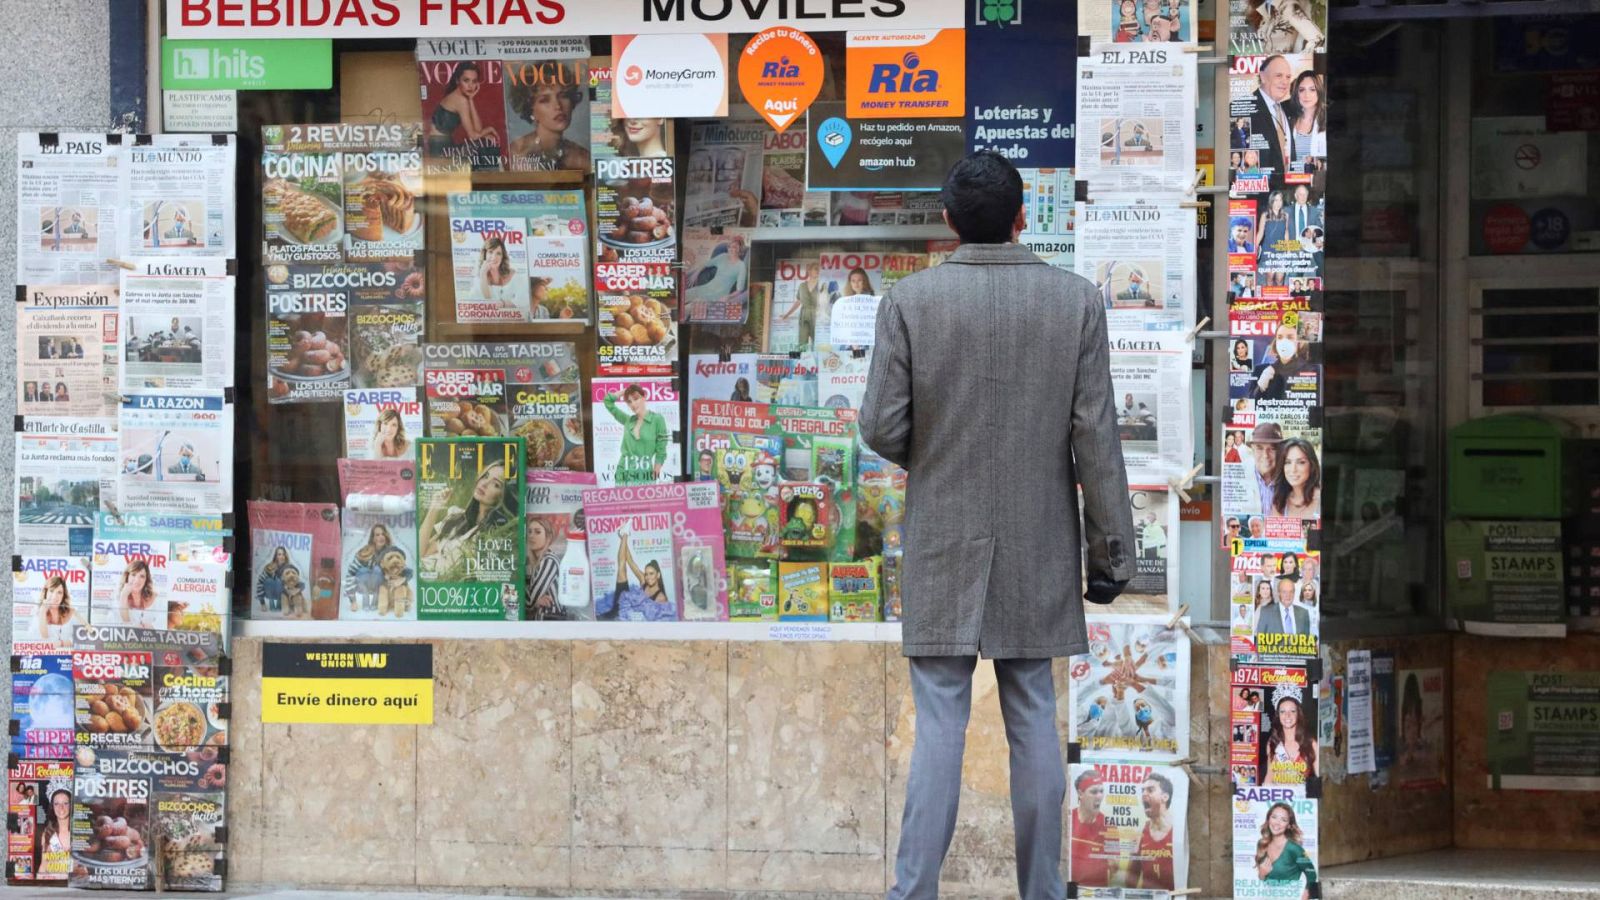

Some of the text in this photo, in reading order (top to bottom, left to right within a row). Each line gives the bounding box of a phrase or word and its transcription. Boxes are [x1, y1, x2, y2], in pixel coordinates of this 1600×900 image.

[427, 39, 486, 56] VOGUE
[746, 29, 816, 56] Recibe tu dinero
[212, 48, 265, 79] hits
[1101, 51, 1125, 64] EL
[761, 56, 800, 78] Ria
[867, 51, 940, 94] Ria
[645, 68, 717, 82] MoneyGram
[764, 98, 798, 112] Aquí
[860, 100, 950, 109] MONEY TRANSFER
[974, 104, 1053, 123] Loterías y
[290, 124, 403, 143] 2 REVISTAS
[860, 123, 875, 132] Haz
[876, 124, 885, 132] tu
[886, 123, 915, 134] pedido
[927, 123, 962, 133] Amazon,
[974, 123, 1075, 144] Apuestas del
[859, 136, 913, 148] recógelo aquí
[131, 152, 203, 164] EL MUNDO
[344, 151, 421, 173] POSTRES
[859, 157, 916, 167] amazon hub
[264, 154, 339, 178] COCINA
[597, 158, 674, 179] POSTRES
[1085, 210, 1161, 222] EL MUNDO
[452, 219, 506, 233] SABER
[481, 231, 523, 244] VIVIR
[147, 263, 207, 276] LA GACETA
[533, 259, 581, 268] ALERGIAS
[596, 265, 647, 278] SABER
[292, 271, 396, 289] BIZCOCHOS
[606, 277, 675, 290] COCINAR
[33, 290, 109, 309] Expansión
[268, 292, 347, 313] POSTRES
[457, 303, 499, 311] ESPECIAL
[356, 314, 415, 325] BIZCOCHOS
[457, 310, 522, 319] CORONAVIRUS
[426, 344, 491, 359] COCINA
[508, 343, 566, 358] TARDE
[599, 345, 666, 355] 65 RECETAS
[1117, 338, 1161, 351] GACETA
[426, 372, 474, 383] SABER
[436, 383, 503, 396] COCINAR
[140, 397, 156, 408] LA
[346, 391, 401, 405] SABER
[516, 391, 569, 403] Cocina
[376, 403, 420, 416] VIVIR
[35, 421, 60, 433] Norte
[70, 422, 105, 434] Castilla
[696, 414, 771, 429] PERDIDO SU COLA
[790, 417, 845, 435] REGALOS
[30, 453, 48, 462] Junta
[49, 454, 76, 462] reclama
[91, 454, 115, 463] fondos
[420, 442, 518, 481] ELLE
[582, 488, 634, 504] REGALO
[637, 484, 686, 500] COSMO
[94, 542, 151, 556] SABER
[477, 538, 513, 552] LOVE
[124, 554, 167, 568] VIVIR
[465, 551, 518, 575] planet
[1491, 557, 1556, 571] STAMPS
[42, 569, 86, 583] VIVIR
[172, 584, 217, 593] ALERGIAS
[75, 627, 138, 642] COCINA
[158, 632, 211, 646] TARDE
[1257, 633, 1316, 646] RUPTURA
[13, 643, 56, 651] ESPECIAL
[73, 654, 121, 666] SABER
[306, 652, 354, 661] WESTERN
[358, 652, 388, 668] WU
[320, 660, 354, 668] UNION
[82, 665, 150, 679] COCINAR
[163, 674, 216, 687] Cocina
[326, 693, 378, 706] dinero
[383, 693, 418, 710] aquí
[1533, 706, 1598, 721] STAMPS
[76, 732, 142, 742] 65 RECETAS
[99, 757, 200, 776] BIZCOCHOS
[1093, 763, 1153, 784] MARCA
[74, 776, 149, 798] POSTRES
[1108, 784, 1137, 795] ELLOS
[1236, 788, 1294, 802] SABER
[158, 801, 215, 812] BIZCOCHOS
[1112, 805, 1132, 816] NOS
[1104, 816, 1139, 827] FALLAN
